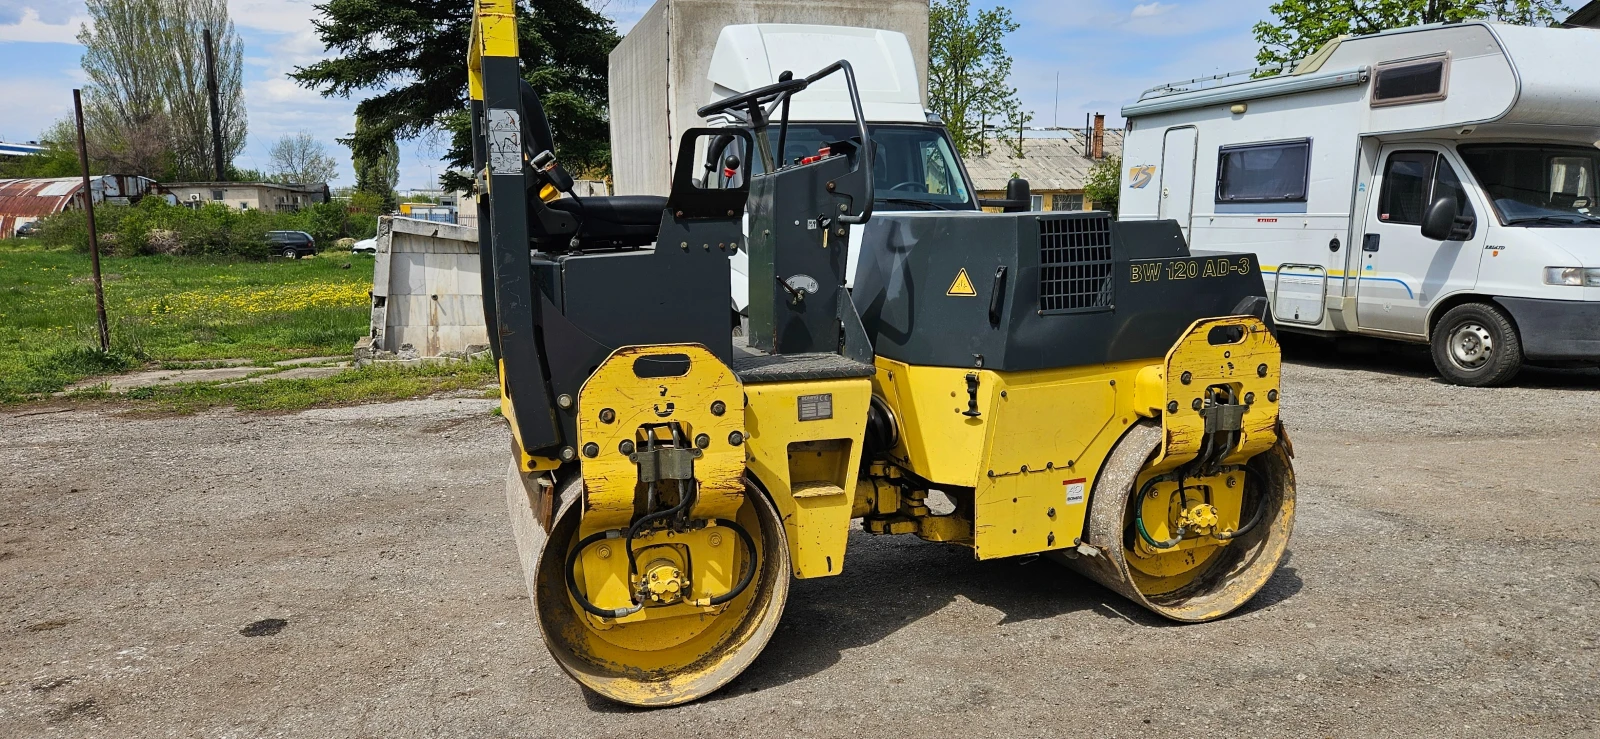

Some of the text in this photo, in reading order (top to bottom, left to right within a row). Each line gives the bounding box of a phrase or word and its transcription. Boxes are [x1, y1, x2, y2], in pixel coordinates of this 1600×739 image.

[1130, 257, 1250, 283] BW 120 AD-3
